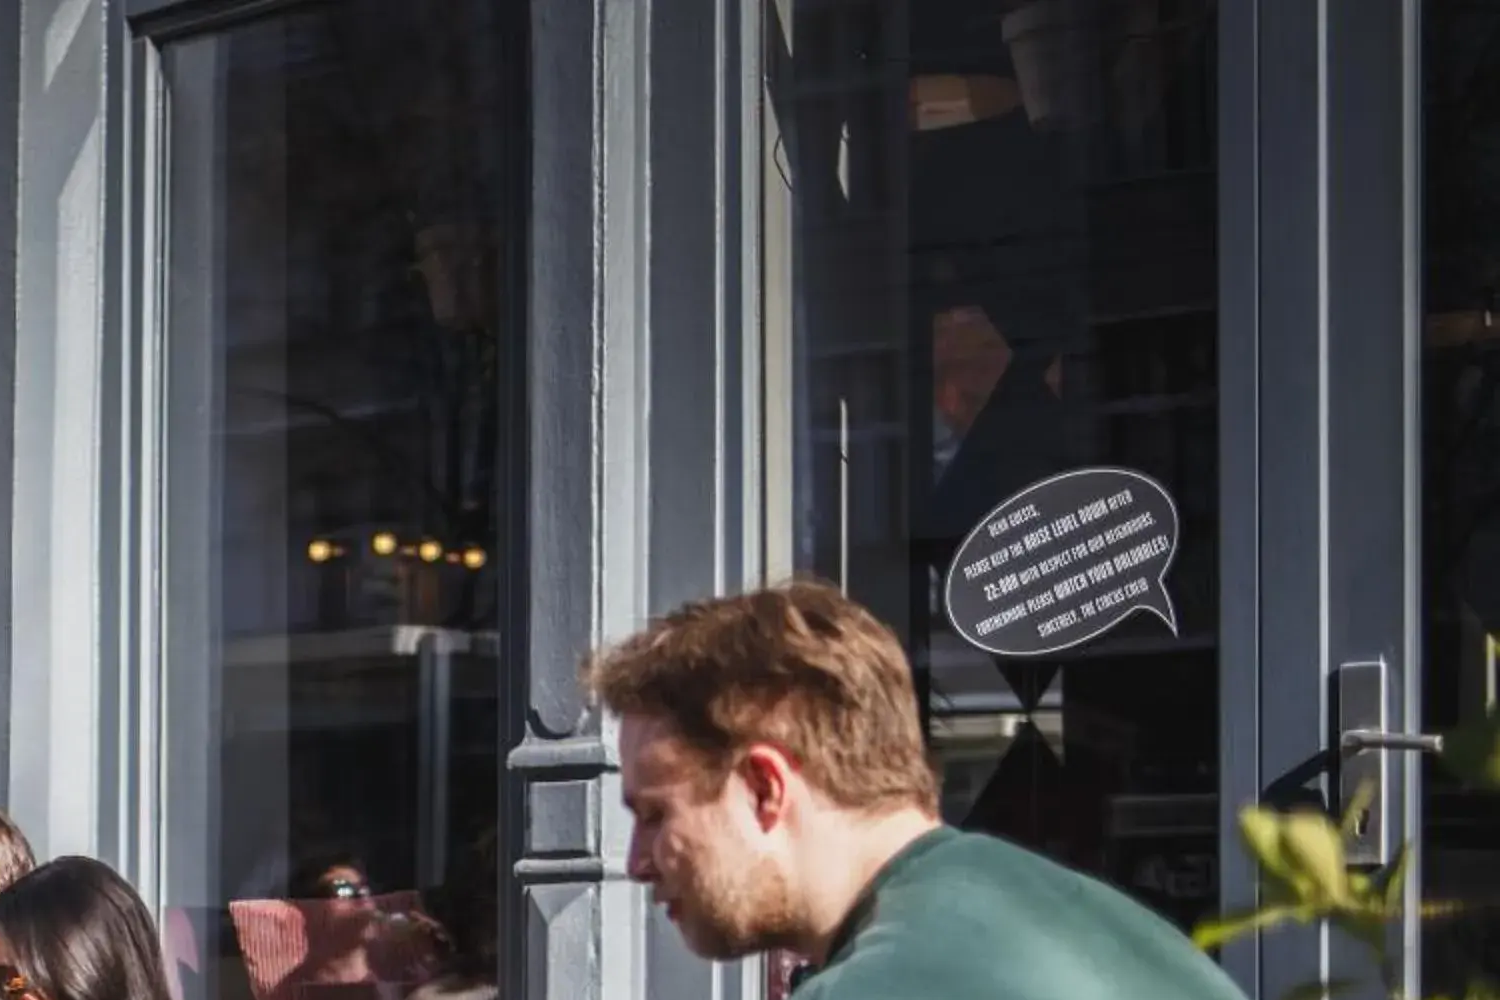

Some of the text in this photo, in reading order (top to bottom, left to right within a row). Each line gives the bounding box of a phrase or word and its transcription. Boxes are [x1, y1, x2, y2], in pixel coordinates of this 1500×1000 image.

[964, 557, 991, 580] PLEASE
[1023, 525, 1052, 551] NOISE
[1050, 513, 1080, 538] LEVEL
[1078, 498, 1108, 525] DOWN
[1039, 548, 1073, 576] RESPECT
[1071, 543, 1089, 561] FOR
[1026, 589, 1056, 614] PLEASE
[1053, 572, 1089, 601] WATCH
[1086, 560, 1115, 585] YOUR
[1095, 586, 1126, 612] CIRCUS
[1124, 576, 1149, 598] CREW
